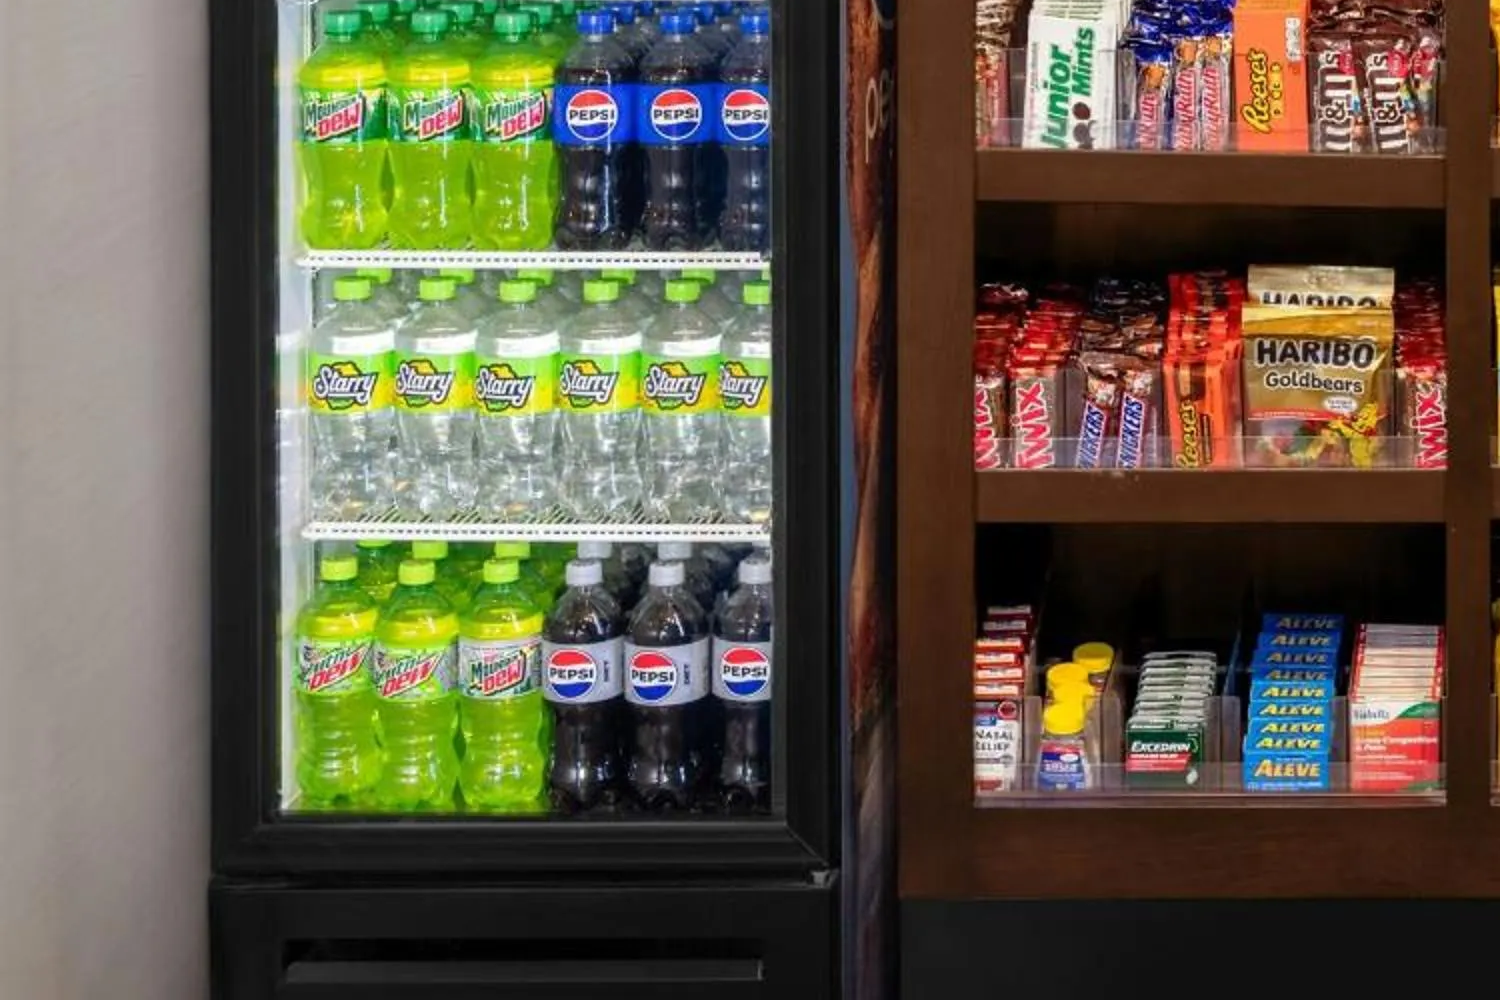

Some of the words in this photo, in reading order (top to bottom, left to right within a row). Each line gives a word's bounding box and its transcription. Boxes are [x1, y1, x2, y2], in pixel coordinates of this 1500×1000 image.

[1071, 27, 1096, 97] Mints
[1040, 44, 1073, 149] Junior
[569, 109, 615, 121] PEPSI
[653, 108, 699, 120] PEPSI
[725, 109, 769, 121] PEPSI
[1257, 338, 1376, 369] HARIBO
[314, 365, 376, 405] Starry
[395, 362, 453, 402] Starry
[476, 366, 534, 406] Starry
[561, 364, 618, 404] Starry
[646, 365, 705, 405] Starry
[1265, 371, 1364, 394] Goldbears
[1079, 405, 1105, 468] NICKERS
[550, 668, 594, 680] PEPSI
[631, 670, 675, 682] PEPSI
[723, 665, 767, 677] PEPSI
[1262, 687, 1325, 697] ALEVE
[1259, 703, 1324, 715] ALEVE
[1261, 722, 1325, 733] ALEVE
[1256, 737, 1321, 749] ALEVE
[1254, 759, 1321, 777] ALEVE
